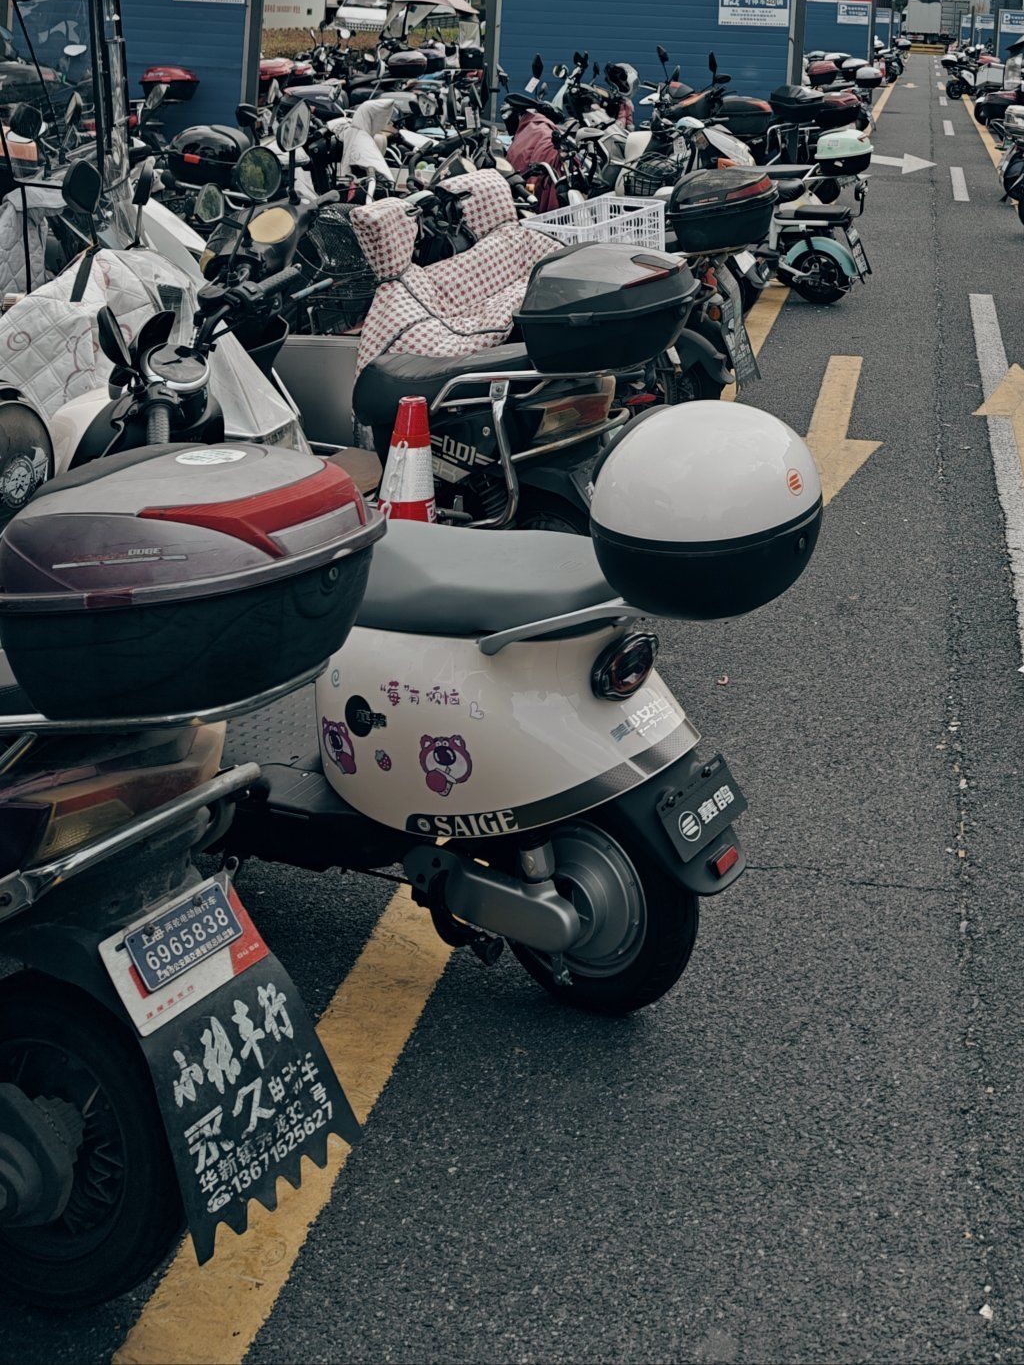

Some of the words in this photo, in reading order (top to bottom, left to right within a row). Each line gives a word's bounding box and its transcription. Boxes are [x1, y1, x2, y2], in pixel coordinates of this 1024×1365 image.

[434, 810, 519, 836] SAIGE
[164, 895, 218, 933] 两轮电动自行车
[146, 907, 229, 970] 6965838
